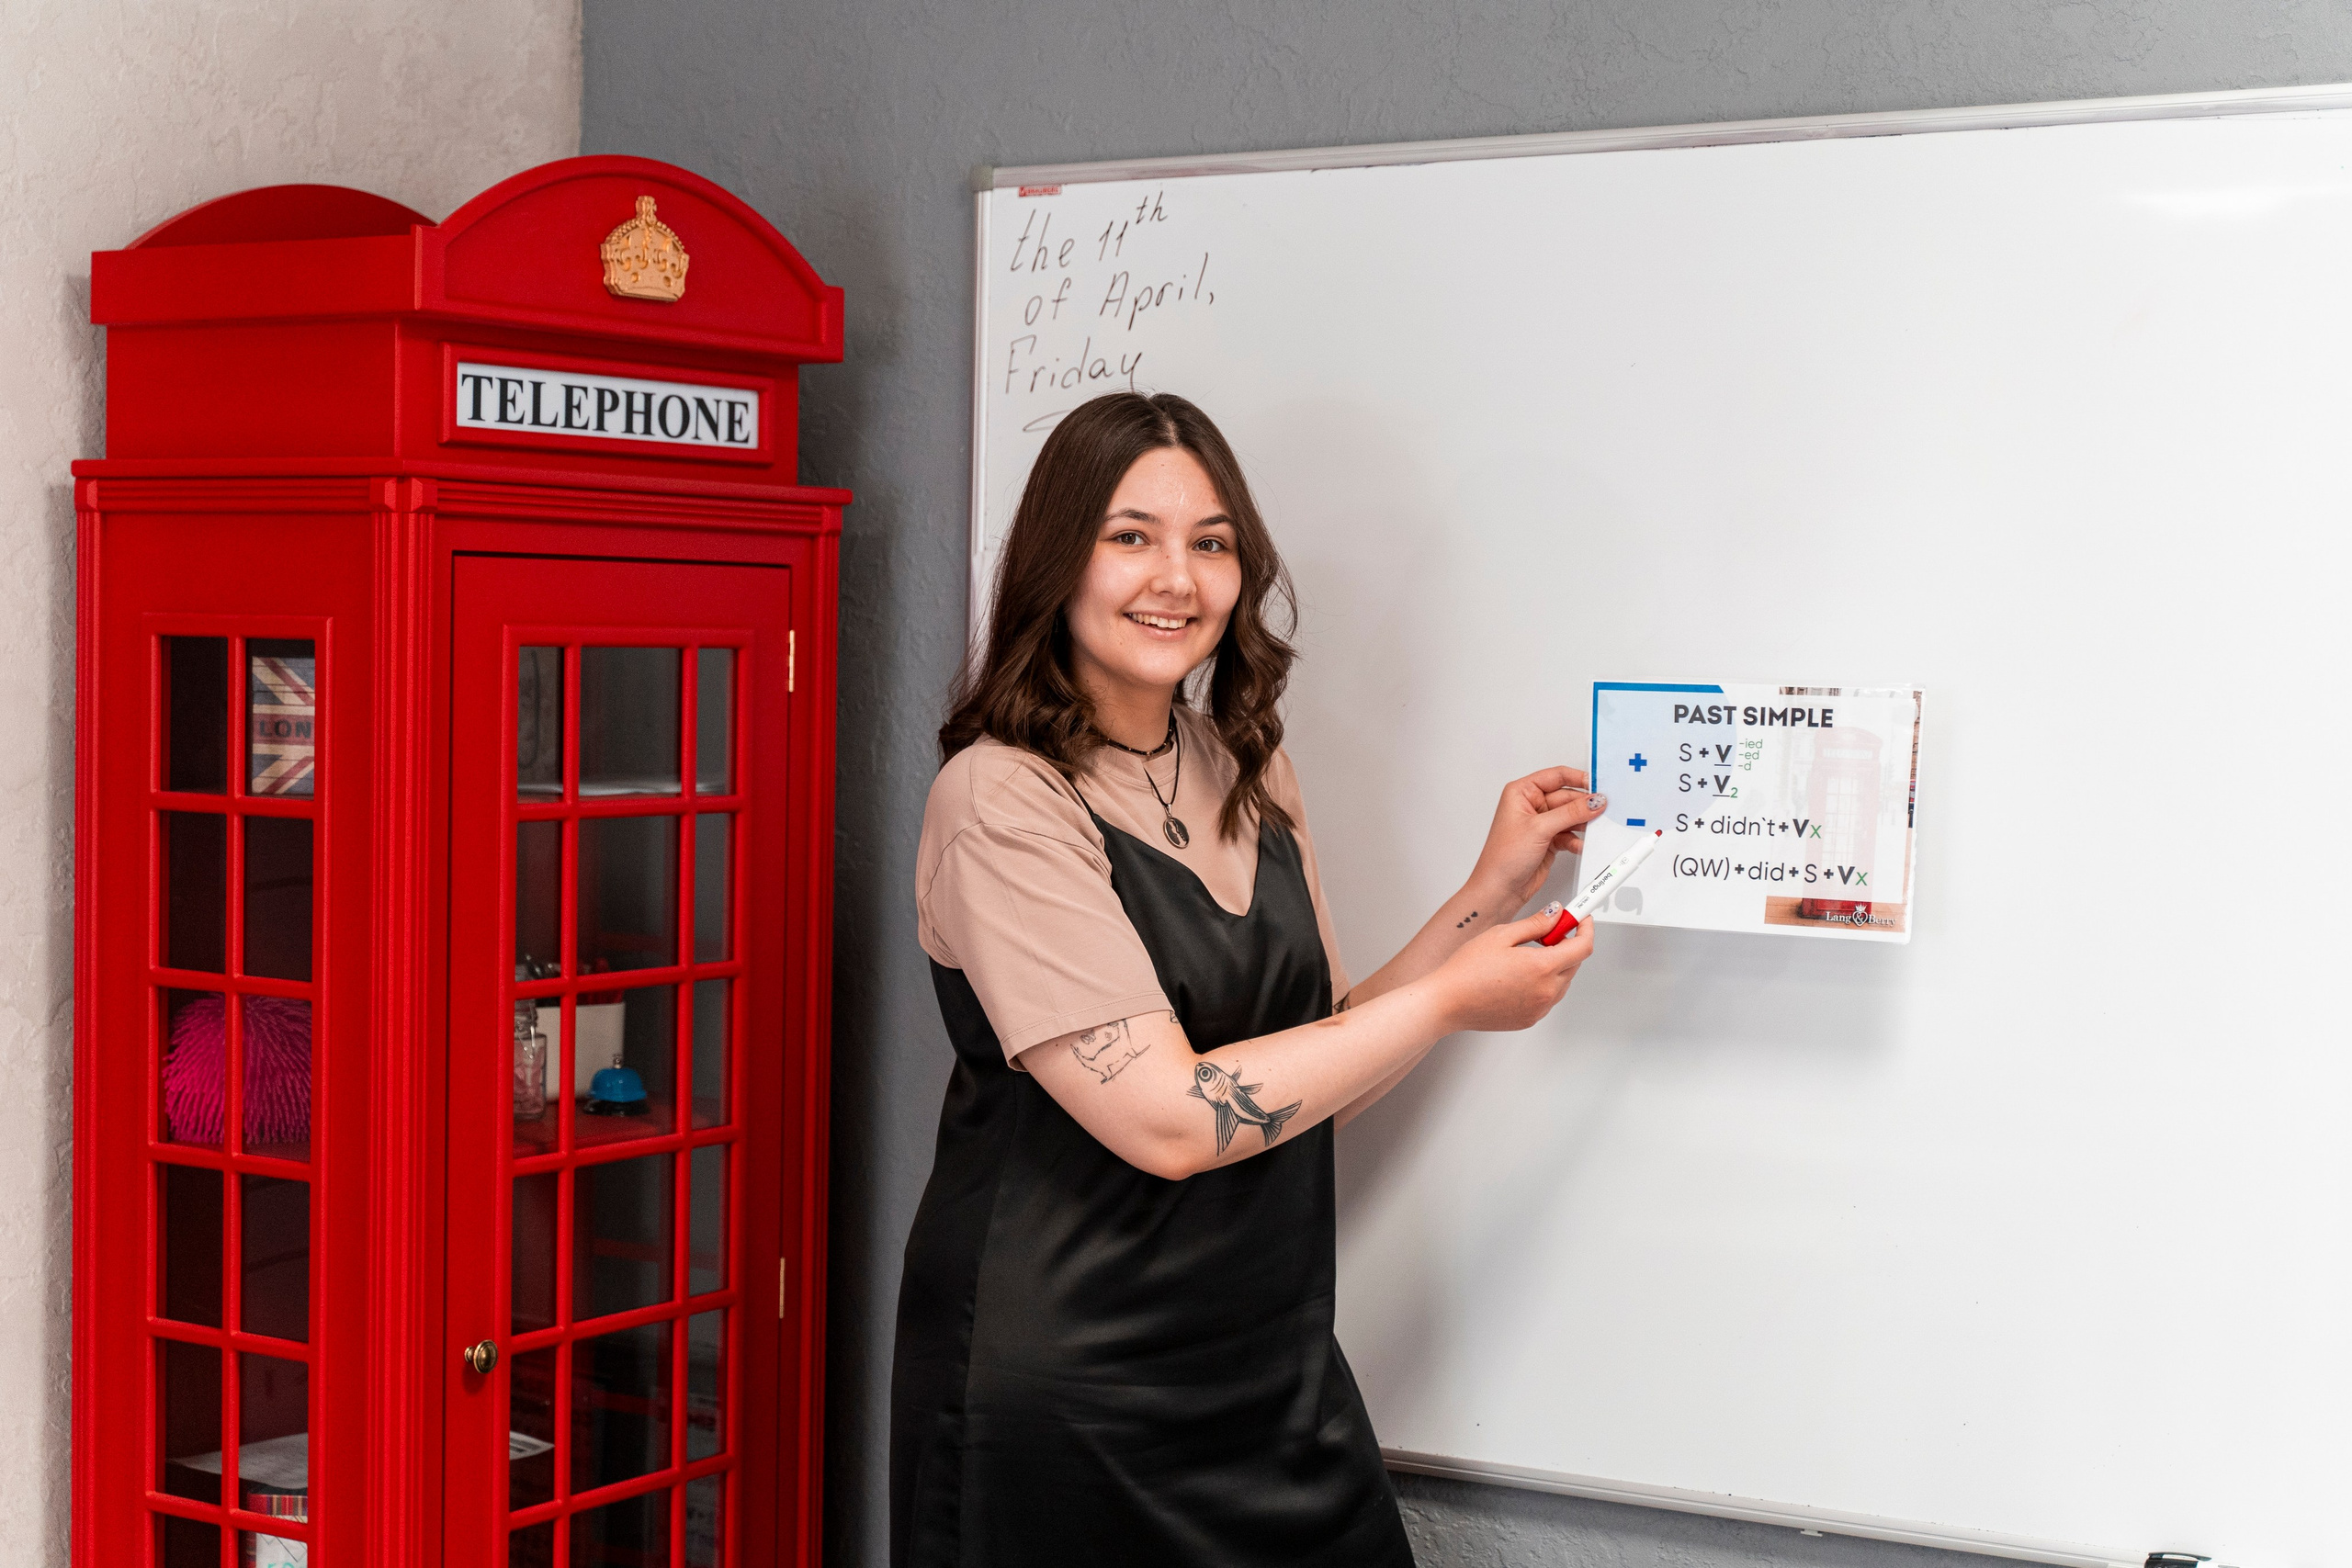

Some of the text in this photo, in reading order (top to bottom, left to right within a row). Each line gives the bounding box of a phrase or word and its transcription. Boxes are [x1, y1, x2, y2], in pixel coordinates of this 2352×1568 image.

[1010, 209, 1075, 273] the
[1024, 252, 1215, 331] of April,
[1005, 334, 1143, 394] Friday
[461, 373, 751, 444] TELEPHONE
[1674, 705, 1834, 728] PAST SIMPLE
[1679, 742, 1692, 762] S
[1679, 773, 1691, 793] S
[1675, 813, 1689, 832] S
[1673, 854, 1730, 881] (QW)
[1747, 862, 1785, 882] did
[1804, 863, 1817, 884] S
[1589, 872, 1613, 894] berlingo
[1826, 910, 1852, 925] Lang
[1868, 913, 1896, 928] Berry
